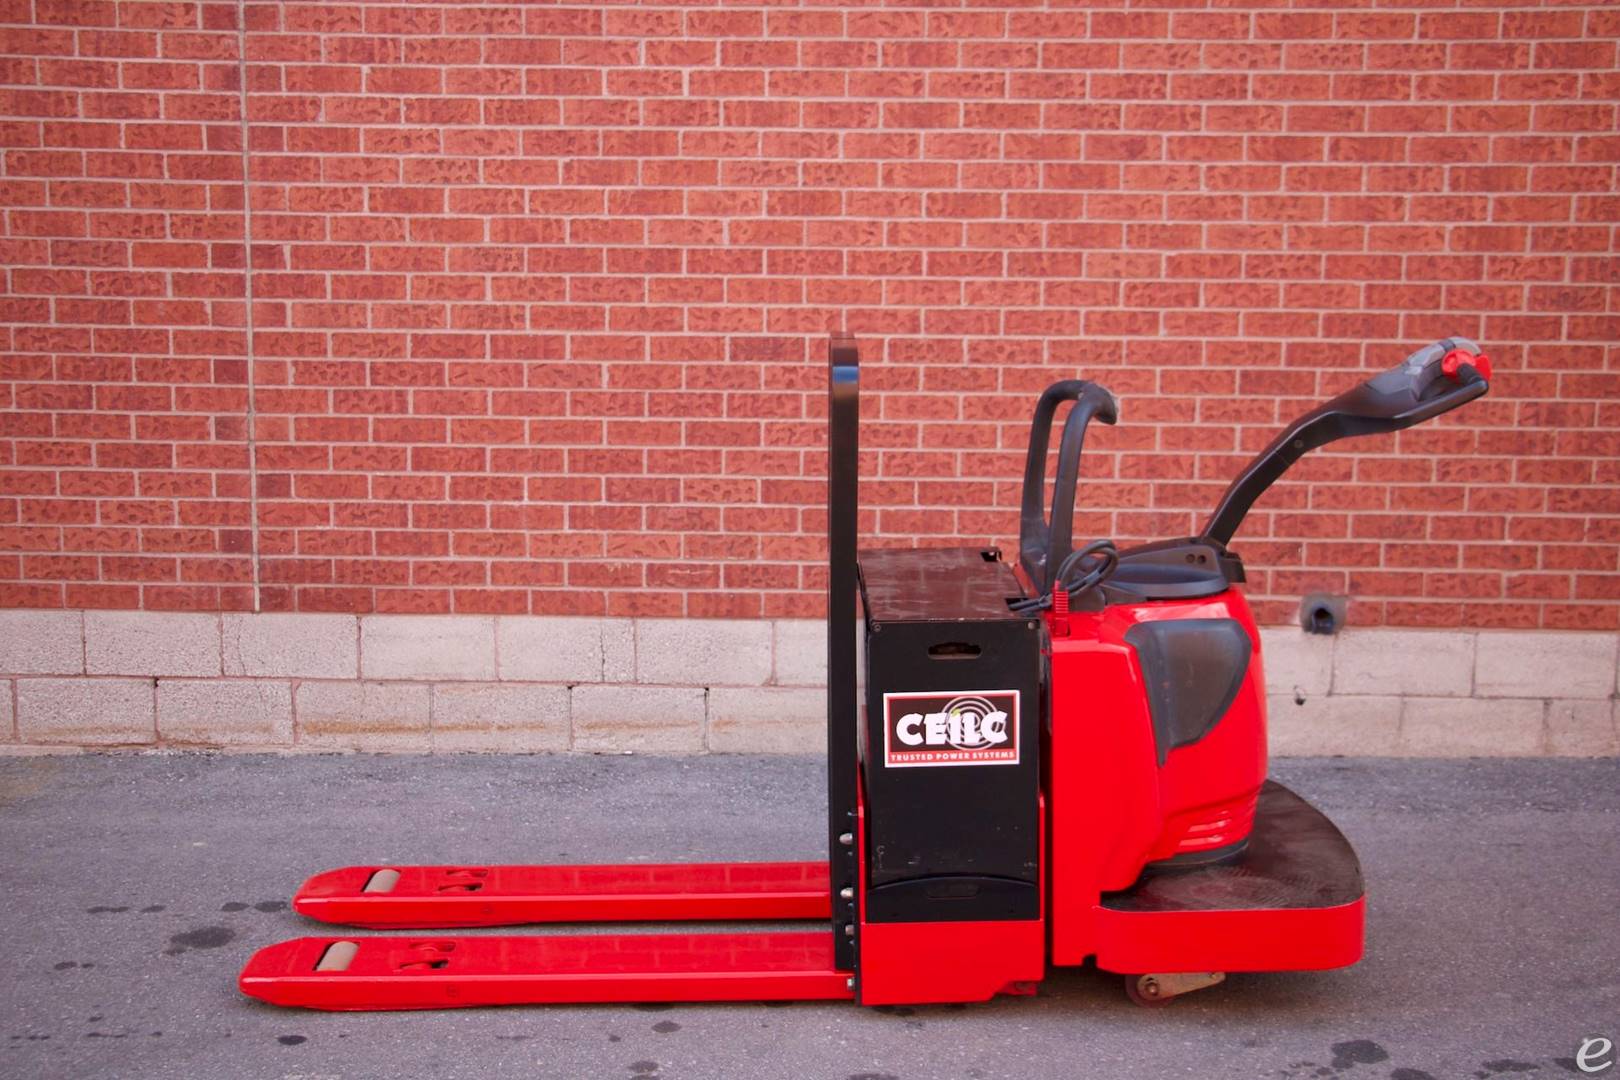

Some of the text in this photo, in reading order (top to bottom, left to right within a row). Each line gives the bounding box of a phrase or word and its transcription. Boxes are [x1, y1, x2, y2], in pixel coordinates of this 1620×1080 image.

[891, 751, 1014, 761] TRUSTED POWER SYSTEMS
